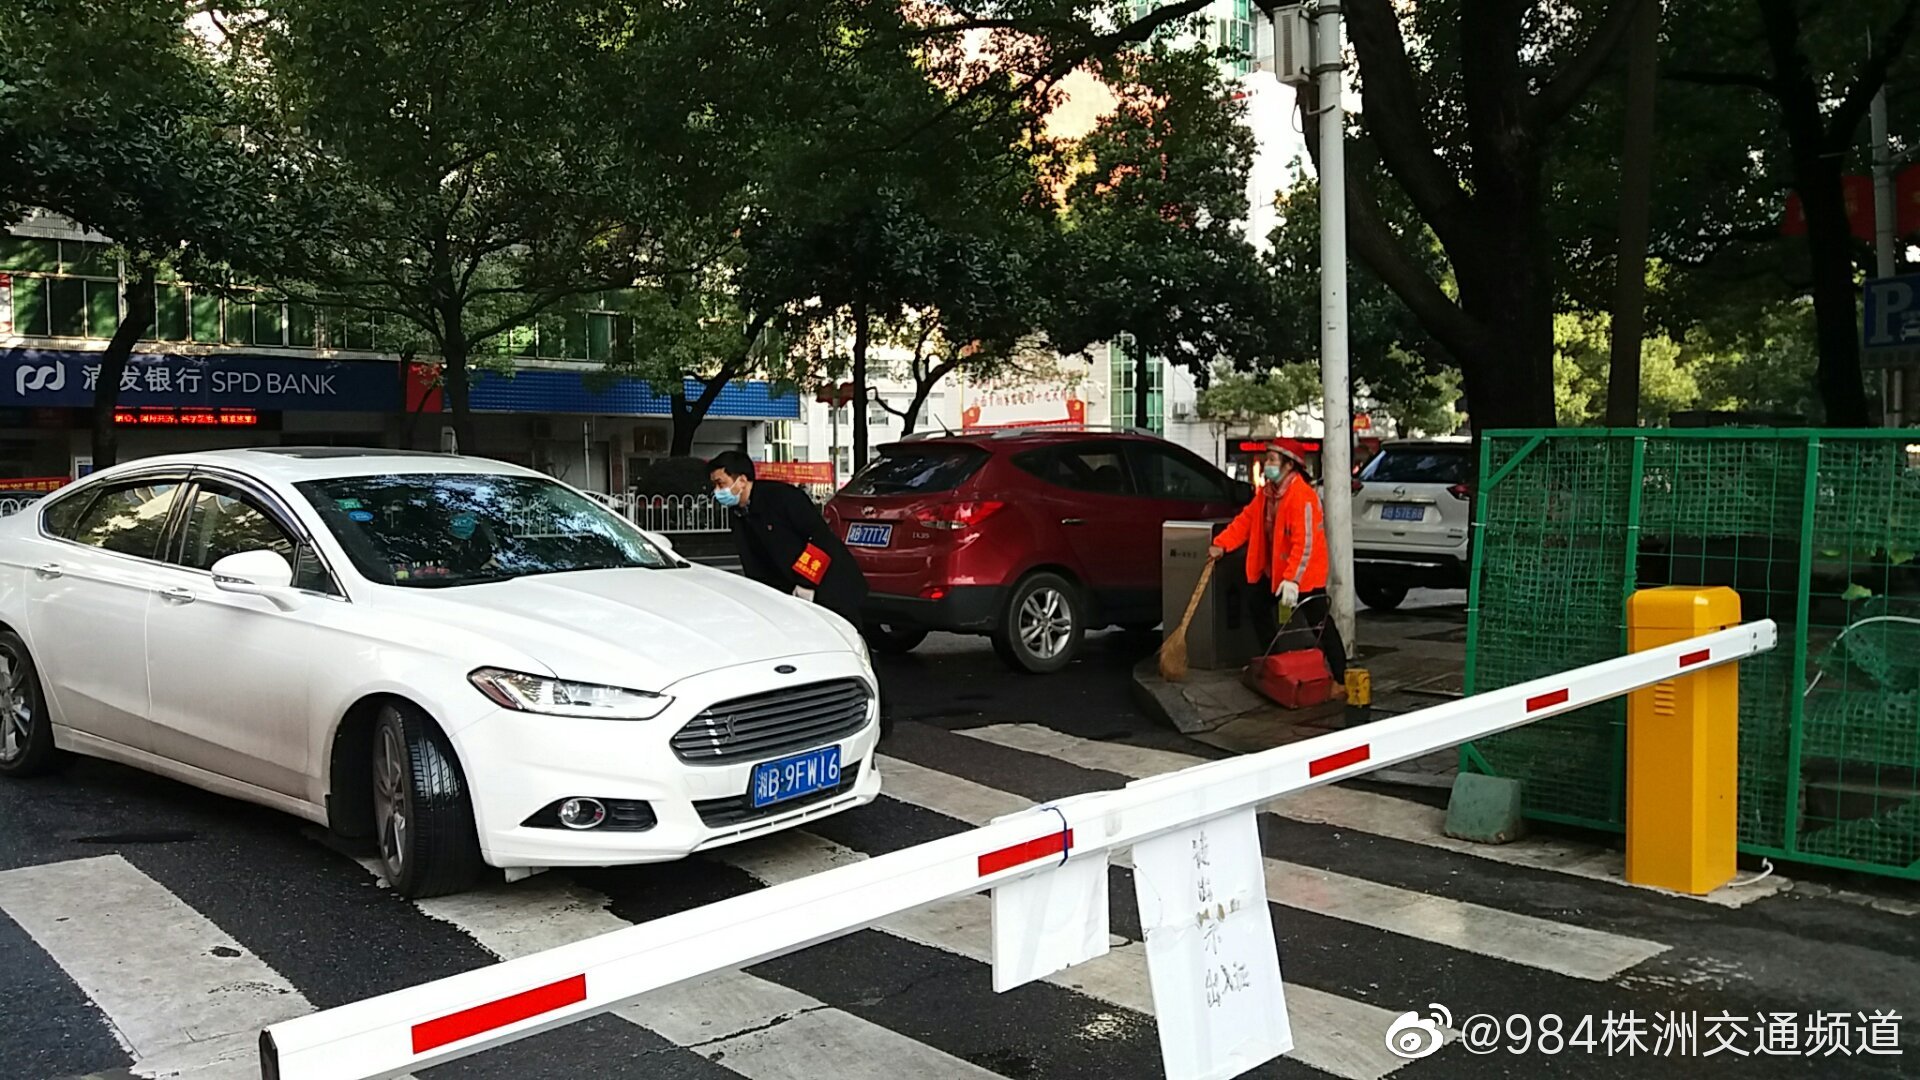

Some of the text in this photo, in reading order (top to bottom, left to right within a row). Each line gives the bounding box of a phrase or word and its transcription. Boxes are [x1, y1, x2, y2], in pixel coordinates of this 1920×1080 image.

[1869, 281, 1914, 345] P
[211, 371, 261, 394] SPD
[266, 373, 337, 395] BANK
